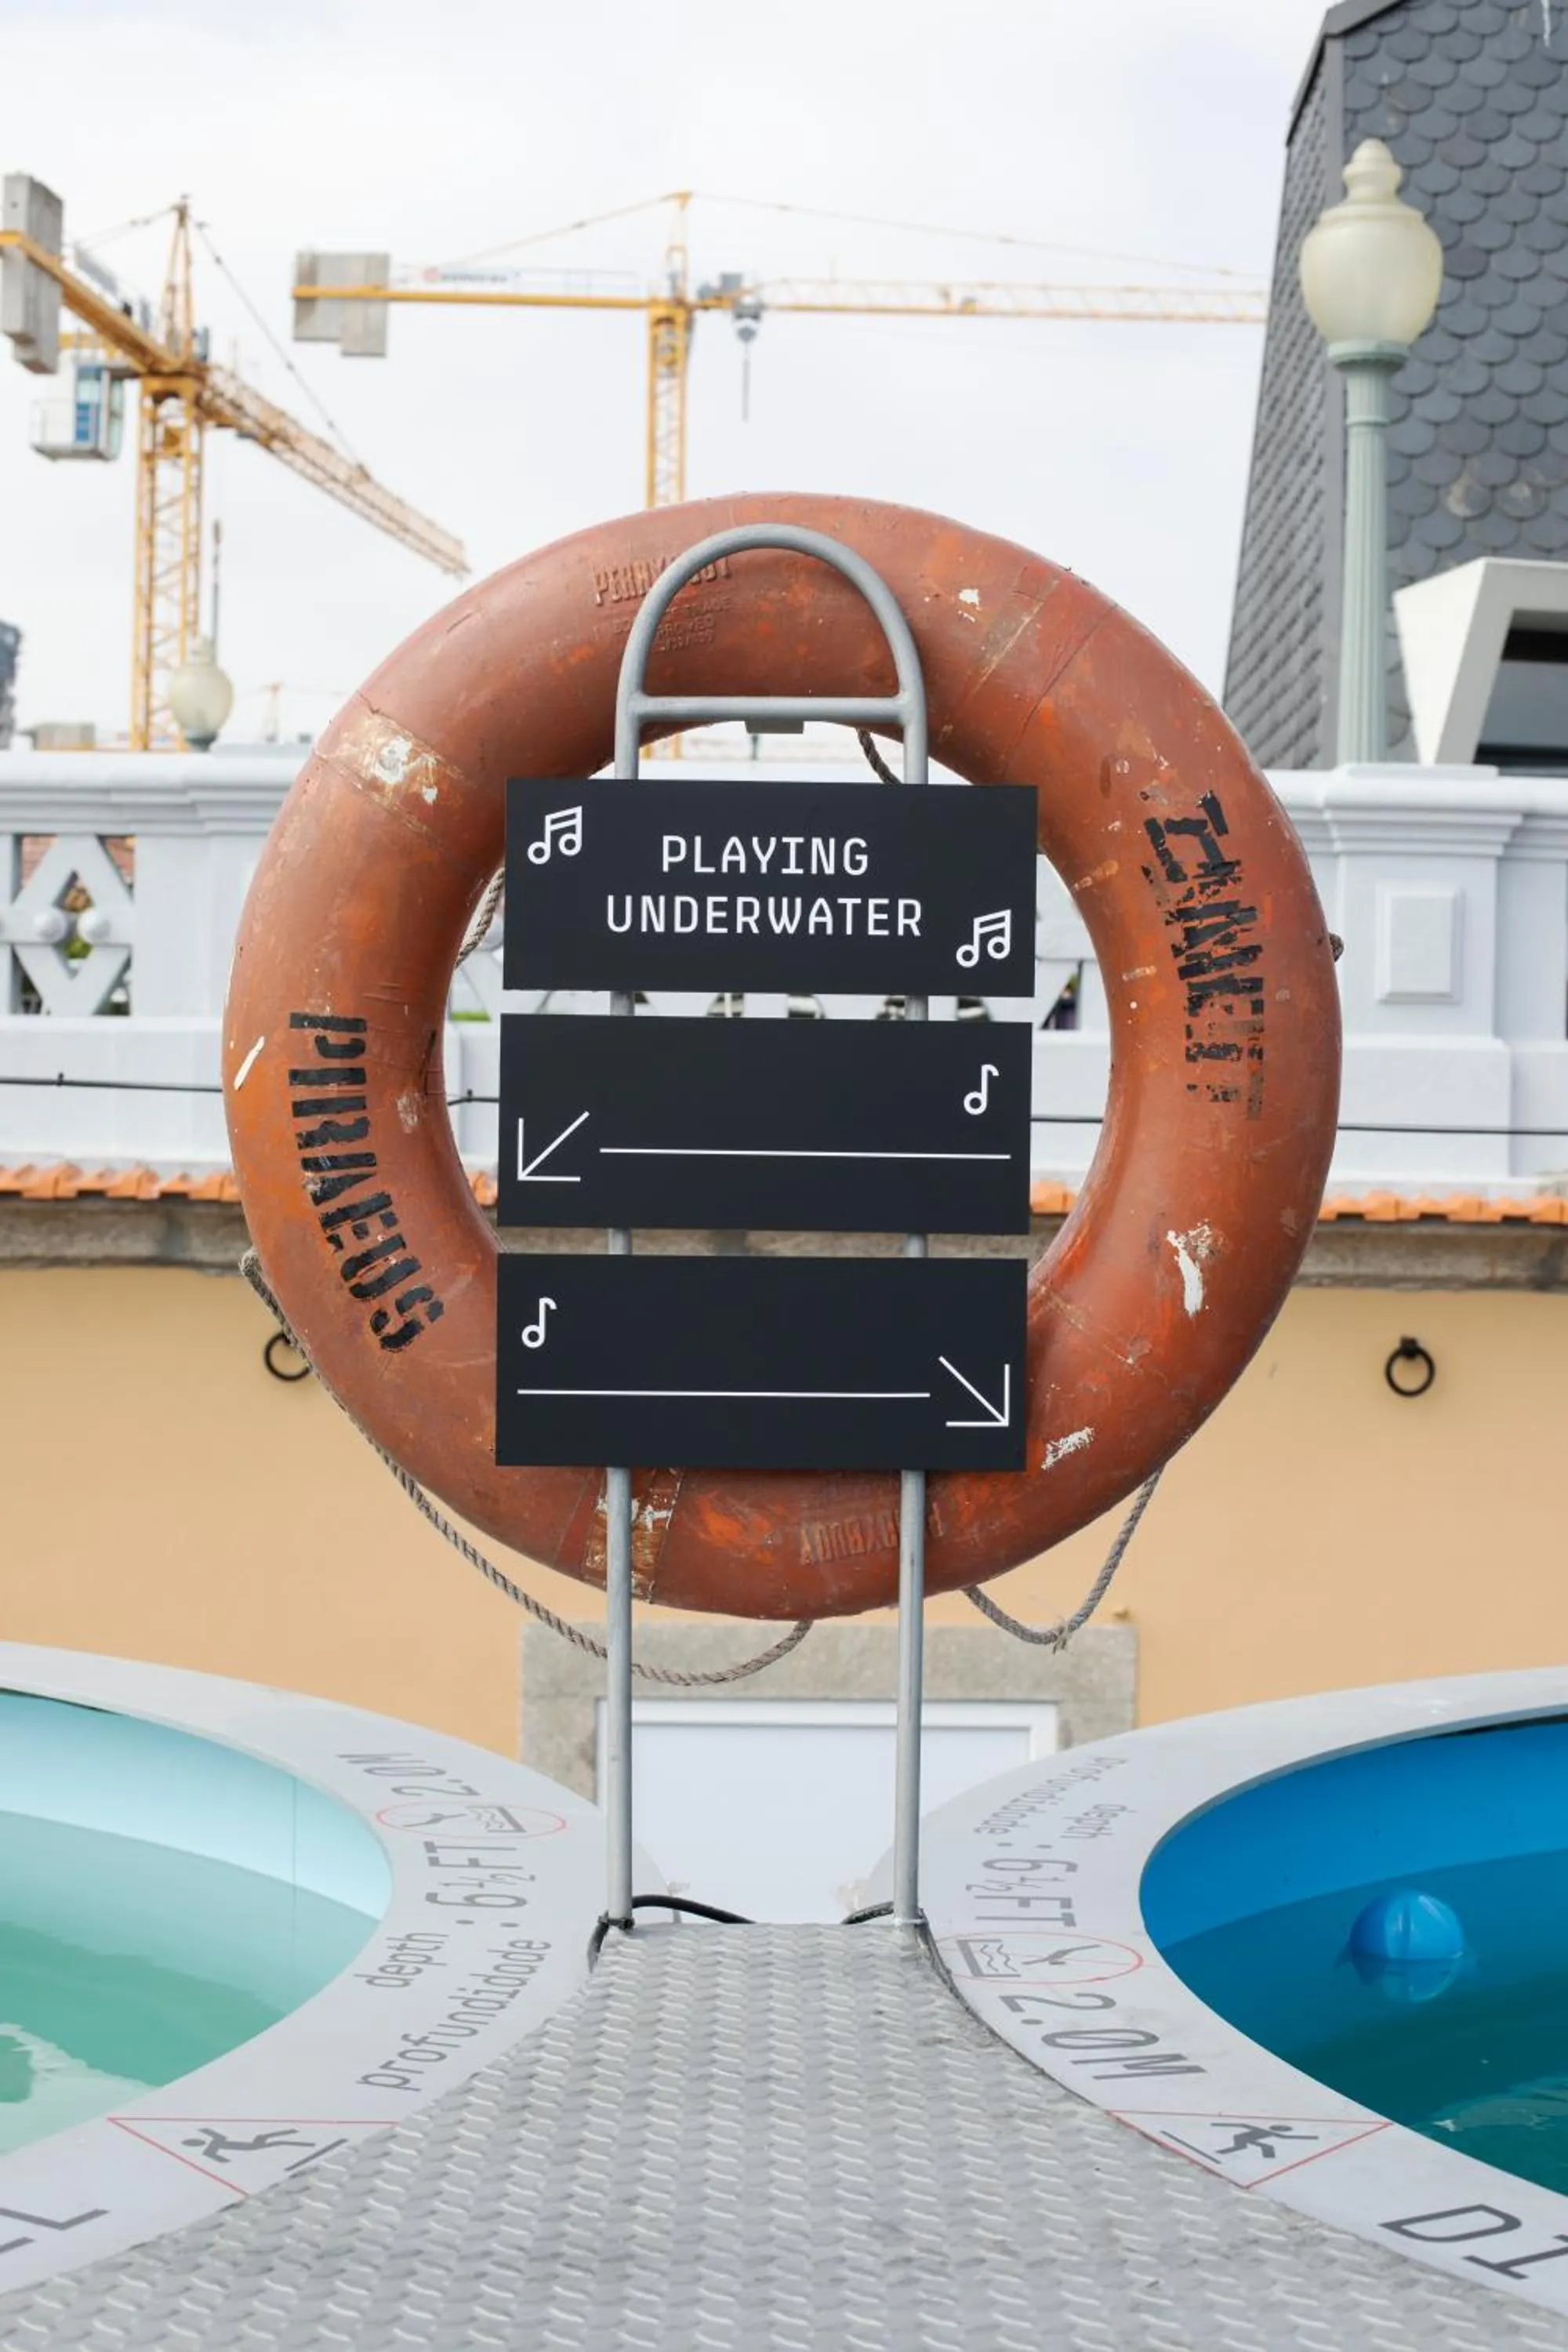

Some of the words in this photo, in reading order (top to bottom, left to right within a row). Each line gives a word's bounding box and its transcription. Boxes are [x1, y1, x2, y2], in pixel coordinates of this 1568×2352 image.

[662, 834, 869, 877] PLAYING
[605, 895, 922, 937] UNDERWATER
[288, 1012, 445, 1352] PIRAEUS
[974, 1755, 1129, 1835] profundidade
[1059, 1802, 1138, 1839] depth
[353, 1932, 449, 1990] depth
[354, 1938, 552, 2092] profundidade
[998, 1992, 1207, 2081] 2.0M
